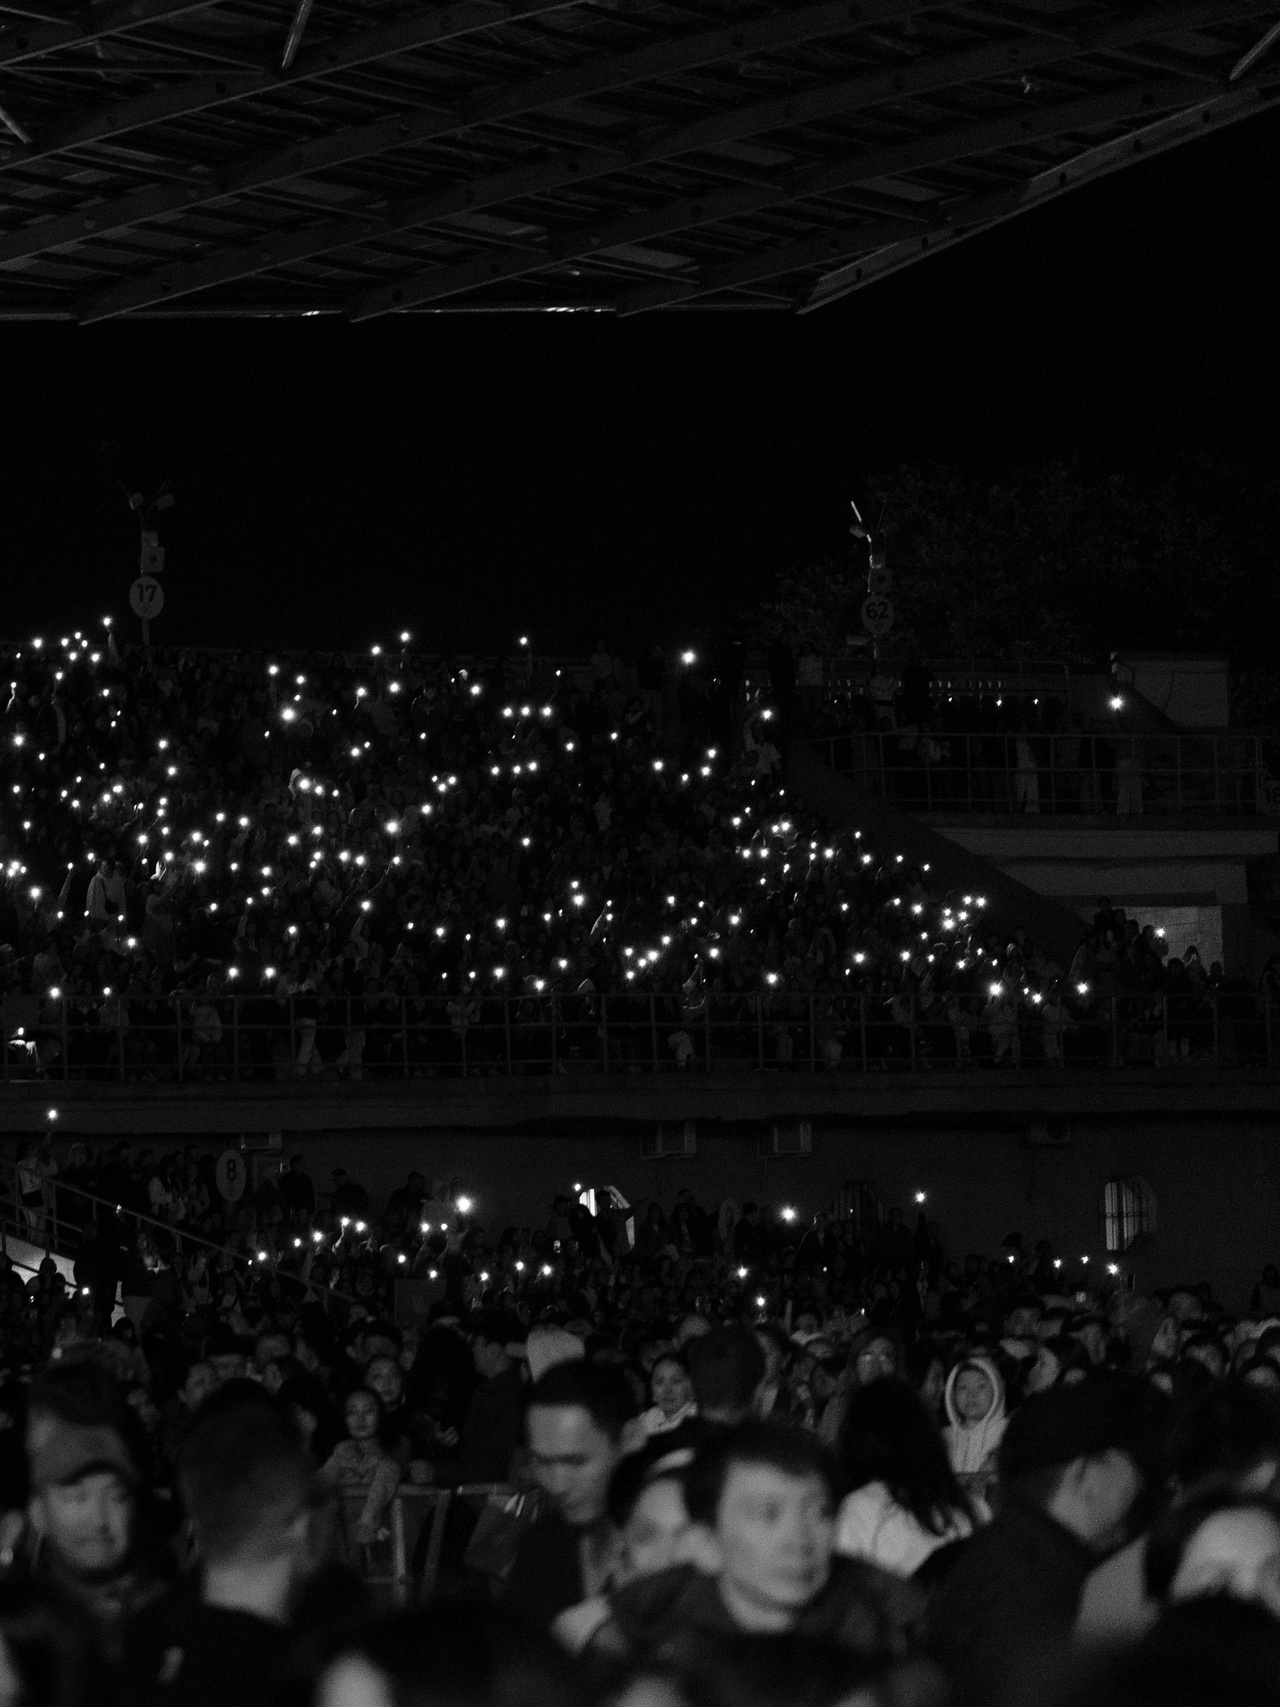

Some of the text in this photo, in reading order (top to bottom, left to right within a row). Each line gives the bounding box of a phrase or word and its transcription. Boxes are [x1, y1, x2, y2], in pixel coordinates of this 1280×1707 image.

[136, 584, 158, 603] 17
[866, 602, 889, 620] 62
[226, 1158, 237, 1182] 8
